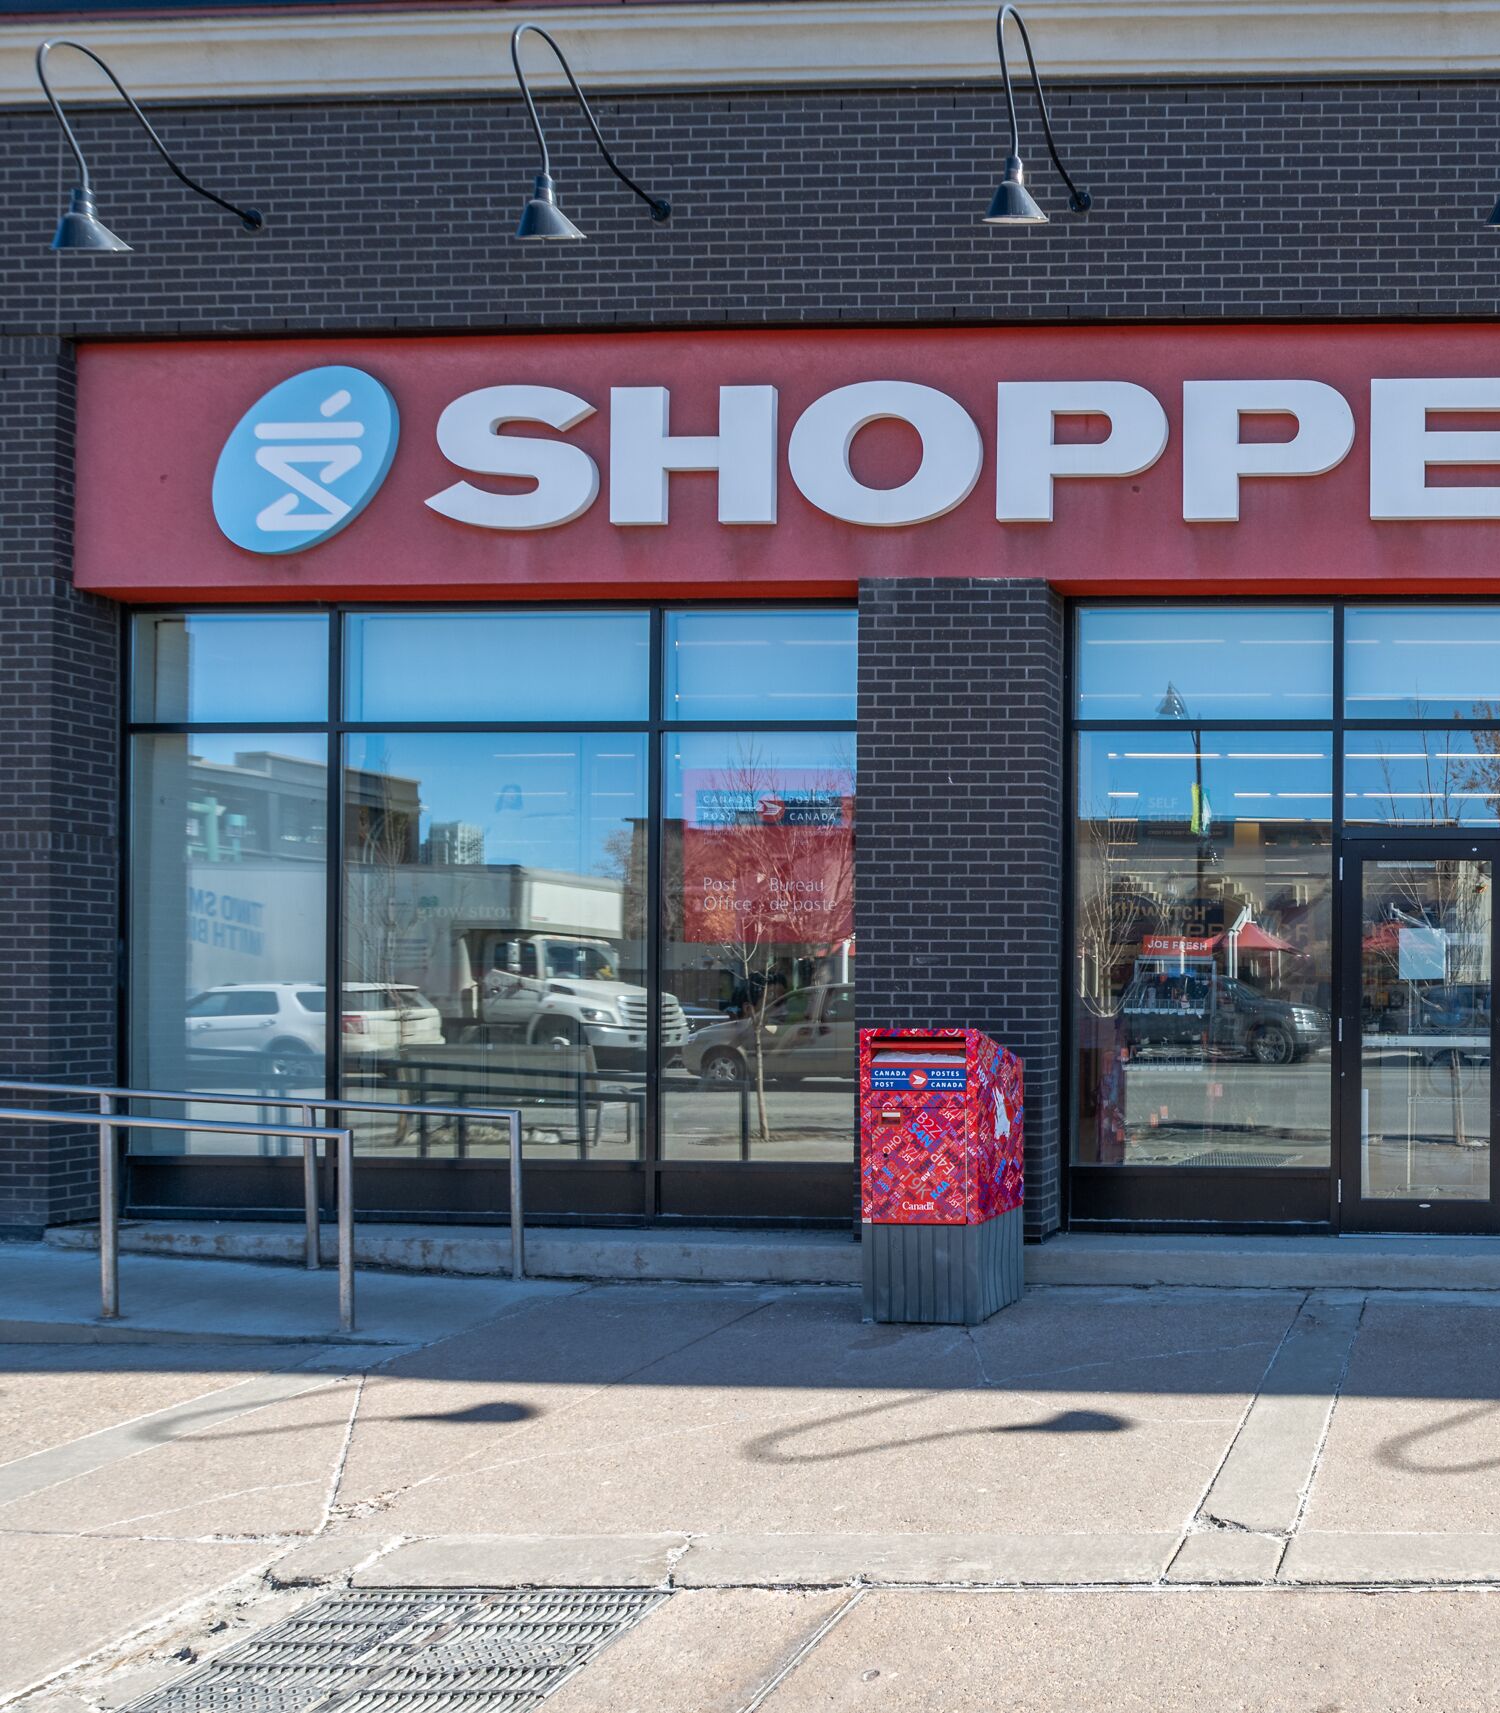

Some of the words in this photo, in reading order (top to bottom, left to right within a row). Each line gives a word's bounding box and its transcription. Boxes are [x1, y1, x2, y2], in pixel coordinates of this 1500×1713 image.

[789, 812, 836, 821] CANADA
[703, 877, 737, 892] Post
[769, 877, 824, 892] Bureau
[703, 896, 752, 911] Office
[770, 896, 788, 911] de
[793, 897, 837, 914] poste
[1147, 939, 1169, 950] JOE
[1172, 940, 1208, 951] FRESH
[916, 1111, 943, 1139] B2Z
[908, 1122, 934, 1148] S4N
[930, 1153, 955, 1176] E4P
[903, 1167, 932, 1201] T9K
[930, 1180, 950, 1200] K4A
[902, 1201, 934, 1211] Canada
